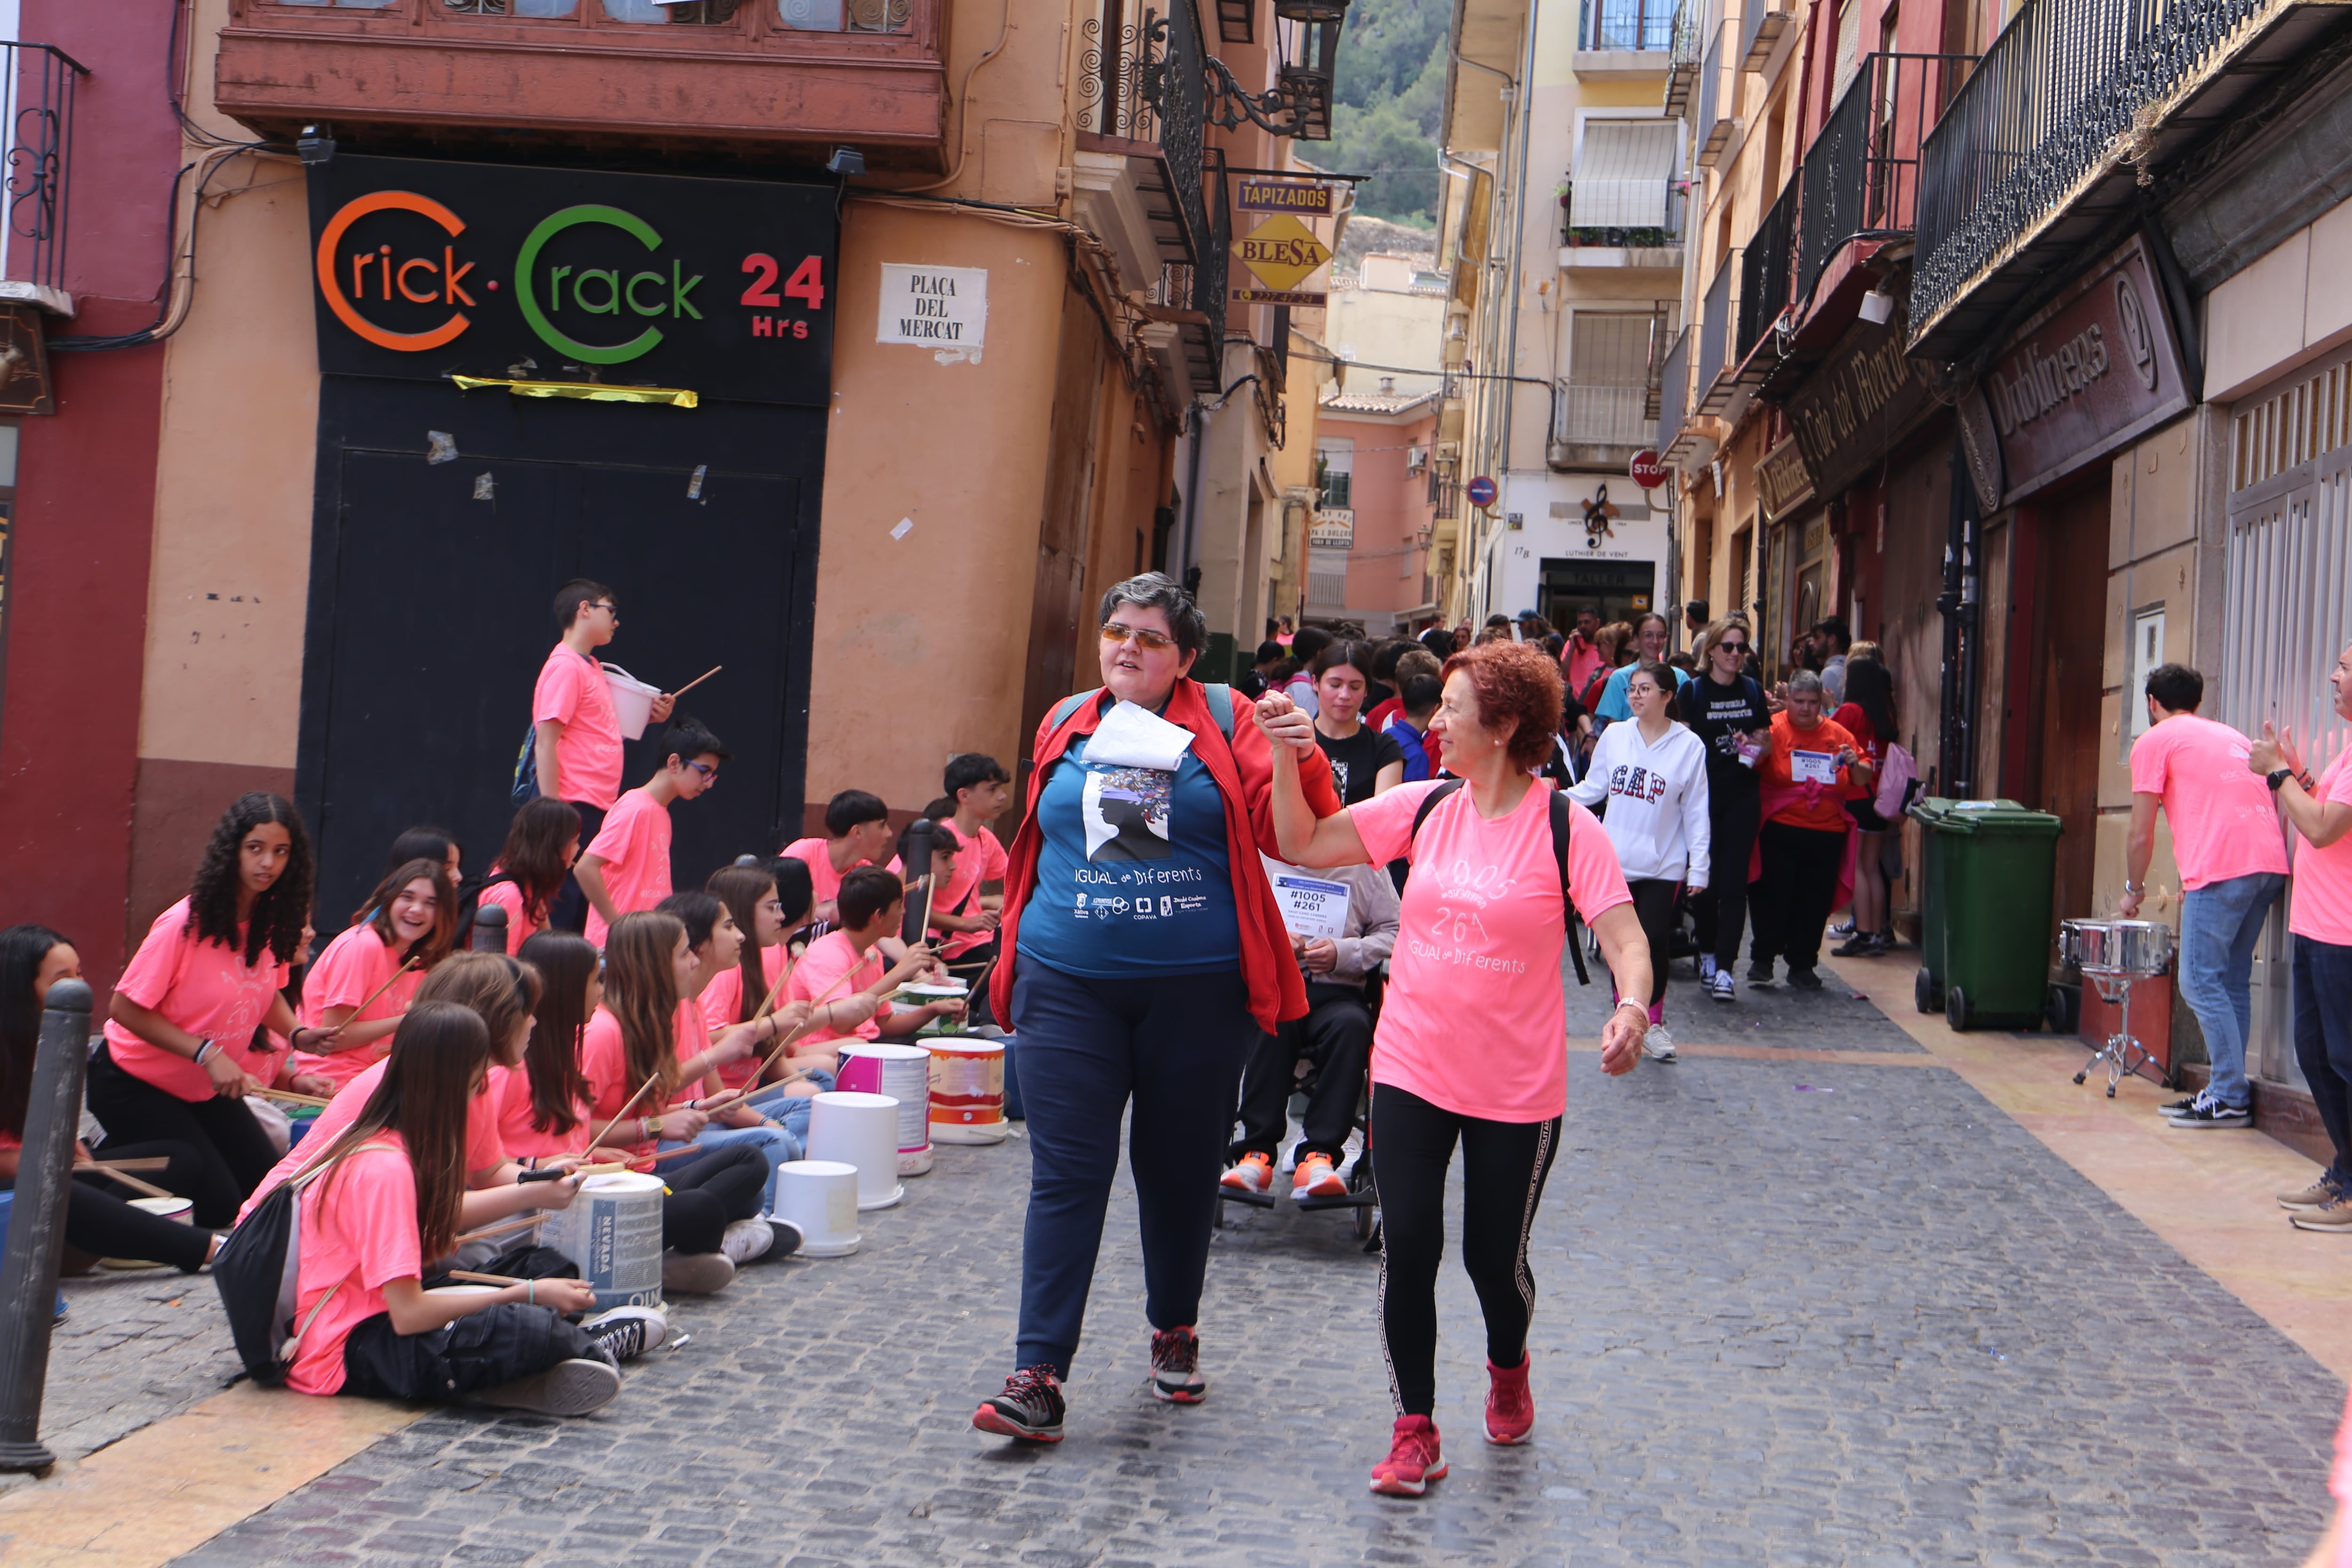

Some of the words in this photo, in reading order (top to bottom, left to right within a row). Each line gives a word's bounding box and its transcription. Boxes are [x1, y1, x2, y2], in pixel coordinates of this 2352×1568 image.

[1243, 186, 1327, 207] TAPIZADOS
[1242, 238, 1320, 266] BLESA
[317, 190, 477, 351] Crick
[740, 253, 824, 310] 24
[515, 204, 704, 364] Crack
[910, 275, 956, 300] PLAÇA
[915, 298, 948, 318] DEL
[1255, 292, 1277, 302] 227
[1280, 293, 1295, 302] 47
[1298, 294, 1313, 303] 24
[753, 315, 808, 339] Hrs
[899, 318, 963, 340] MERCAT
[1992, 323, 2109, 437] Dubliners
[1832, 371, 1857, 439] del
[1634, 464, 1666, 475] STOP
[1574, 573, 1626, 585] TALLER
[1610, 764, 1666, 804] GAP
[1075, 869, 1117, 884] IGUAL
[1121, 874, 1131, 883] de
[1133, 867, 1201, 885] Diferents
[1291, 890, 1326, 902] #1005
[1294, 900, 1320, 911] #261
[1431, 907, 1489, 941] 261
[1453, 947, 1525, 973] Diferents
[600, 1216, 612, 1274] NEVADA
